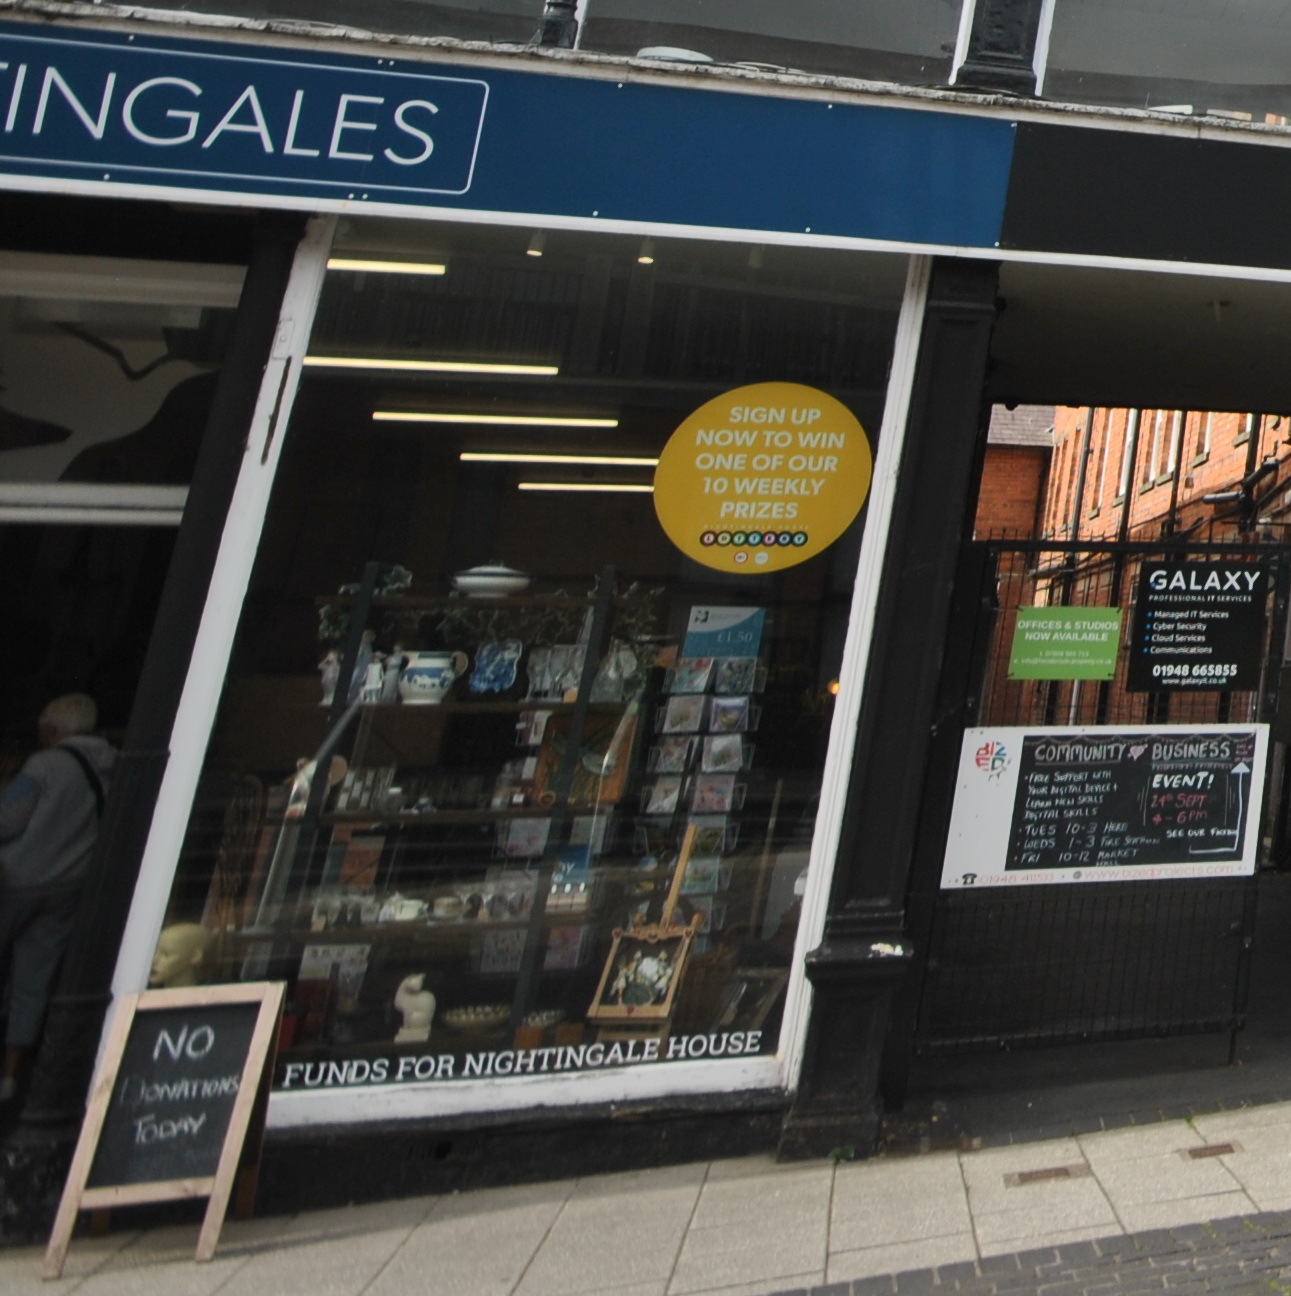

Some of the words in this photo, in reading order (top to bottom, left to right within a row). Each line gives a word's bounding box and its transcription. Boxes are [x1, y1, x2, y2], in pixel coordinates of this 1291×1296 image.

[0, 61, 439, 166] INGALES
[728, 406, 786, 424] SIGN
[790, 408, 822, 425] UP
[695, 429, 759, 447] NOW
[762, 430, 793, 448] TO
[797, 432, 846, 449] WIN
[694, 453, 748, 471] ONE
[751, 453, 785, 472] OF
[787, 455, 839, 473] OUR
[702, 477, 729, 495] 10
[733, 477, 827, 496] WEEKLY
[719, 501, 799, 519] PRIZES
[1149, 569, 1261, 591] GALAXY
[1148, 594, 1206, 602] PROFESSIONAL
[1207, 594, 1215, 602] IT
[1216, 594, 1252, 602] SERVICES
[1153, 610, 1189, 620] Managed
[1190, 610, 1197, 618] IT
[1198, 610, 1230, 619] Services
[1016, 620, 1062, 630] OFFICES
[1063, 621, 1072, 630] &
[1073, 620, 1119, 631] STUDIOS
[1152, 622, 1175, 632] Cyber
[1176, 622, 1207, 632] Security
[1024, 631, 1051, 641] NOW
[1051, 631, 1109, 642] AVAILABLE
[1151, 633, 1174, 643] Cloud
[1174, 633, 1206, 643] Services
[1149, 645, 1213, 655] Communications
[1152, 664, 1190, 677] 01948
[1191, 663, 1238, 677] 665855
[1034, 743, 1127, 762] COMMUNITY
[1151, 740, 1231, 761] BUSINESS
[1084, 783, 1111, 793] DEVICE
[1152, 771, 1215, 790] EVENT!
[1174, 792, 1208, 809] SEPT
[1063, 806, 1099, 818] SKILLS
[1025, 824, 1057, 837] TUES
[1023, 837, 1056, 850] WEDS
[1020, 851, 1041, 864] FRI
[1097, 848, 1139, 860] MARKET
[152, 1023, 216, 1062] NO
[282, 1058, 389, 1088] FUNDS
[395, 1054, 455, 1081] FOR
[461, 1037, 661, 1077] NIGHTINGALE
[666, 1030, 763, 1060] HOUSE
[133, 1112, 207, 1145] TODAY
